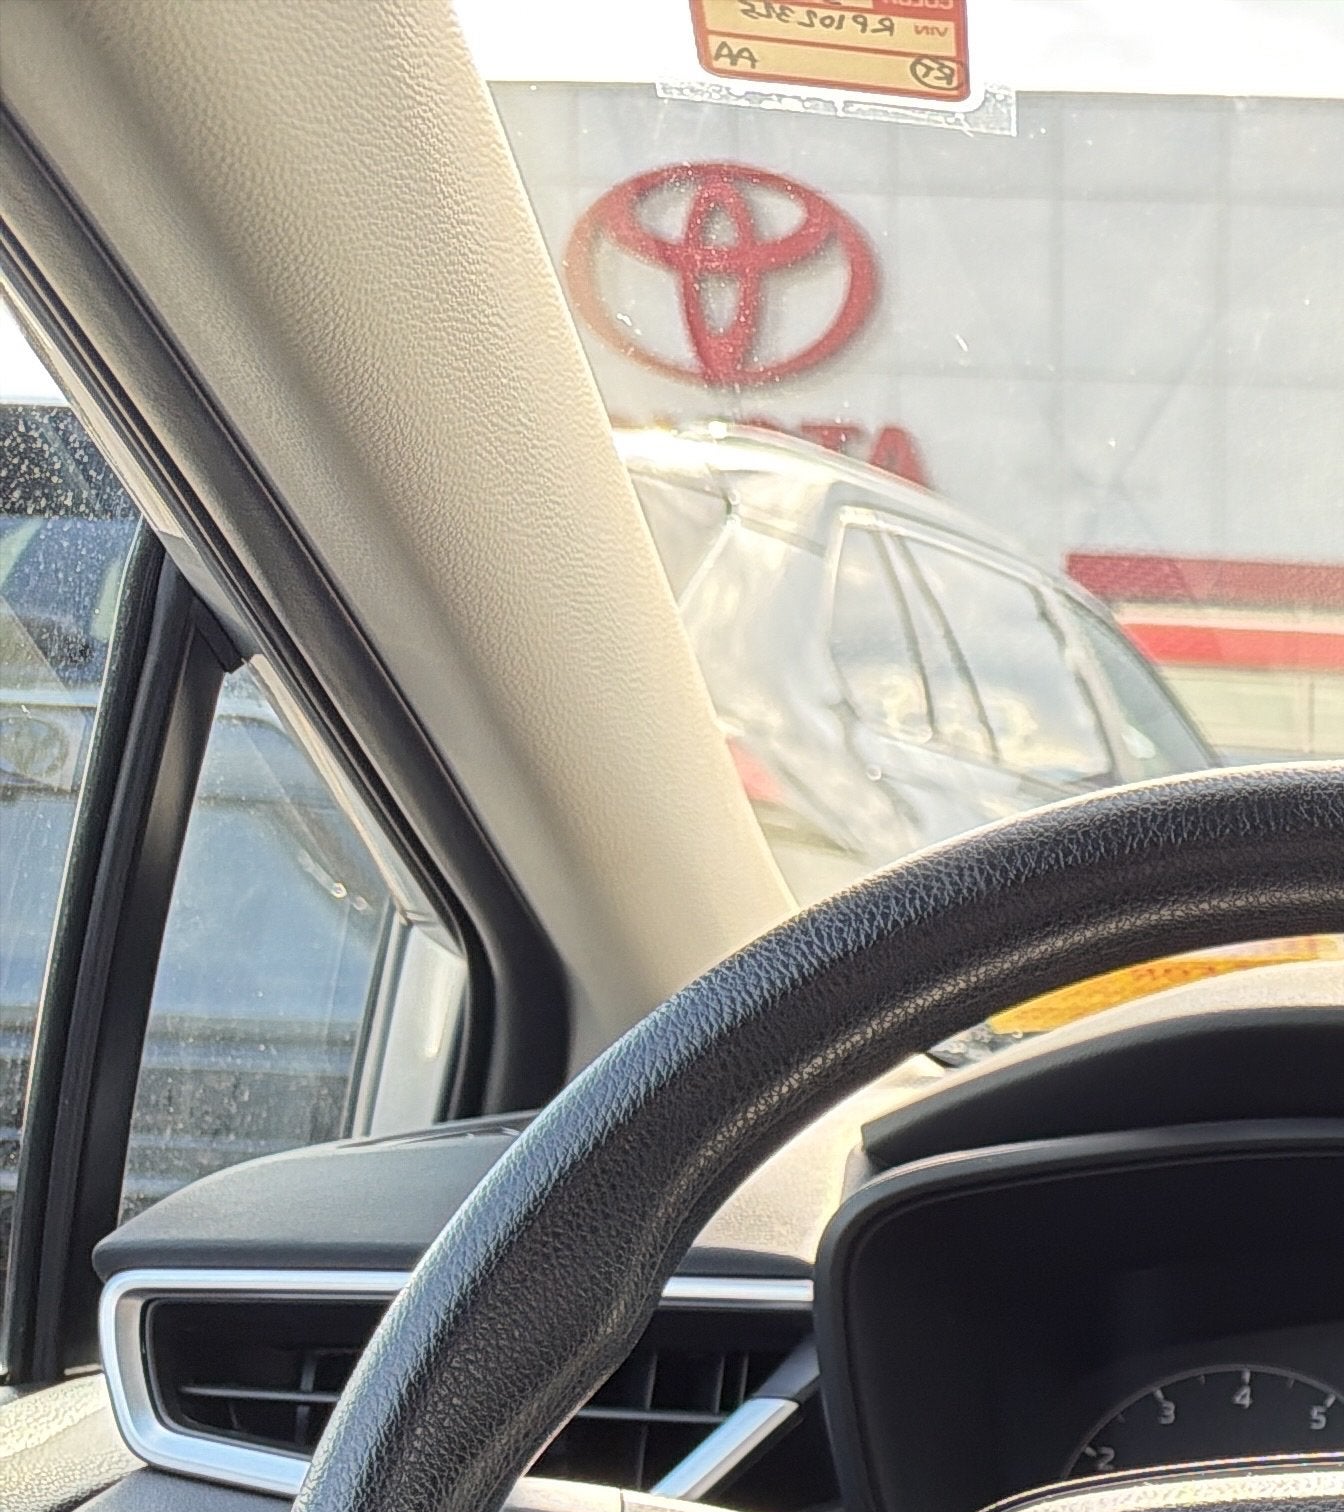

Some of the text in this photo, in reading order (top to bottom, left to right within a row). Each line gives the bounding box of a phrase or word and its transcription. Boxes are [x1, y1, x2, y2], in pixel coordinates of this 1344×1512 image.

[1232, 1385, 1253, 1409] 4
[1157, 1400, 1176, 1425] 3
[1309, 1405, 1327, 1431] 5
